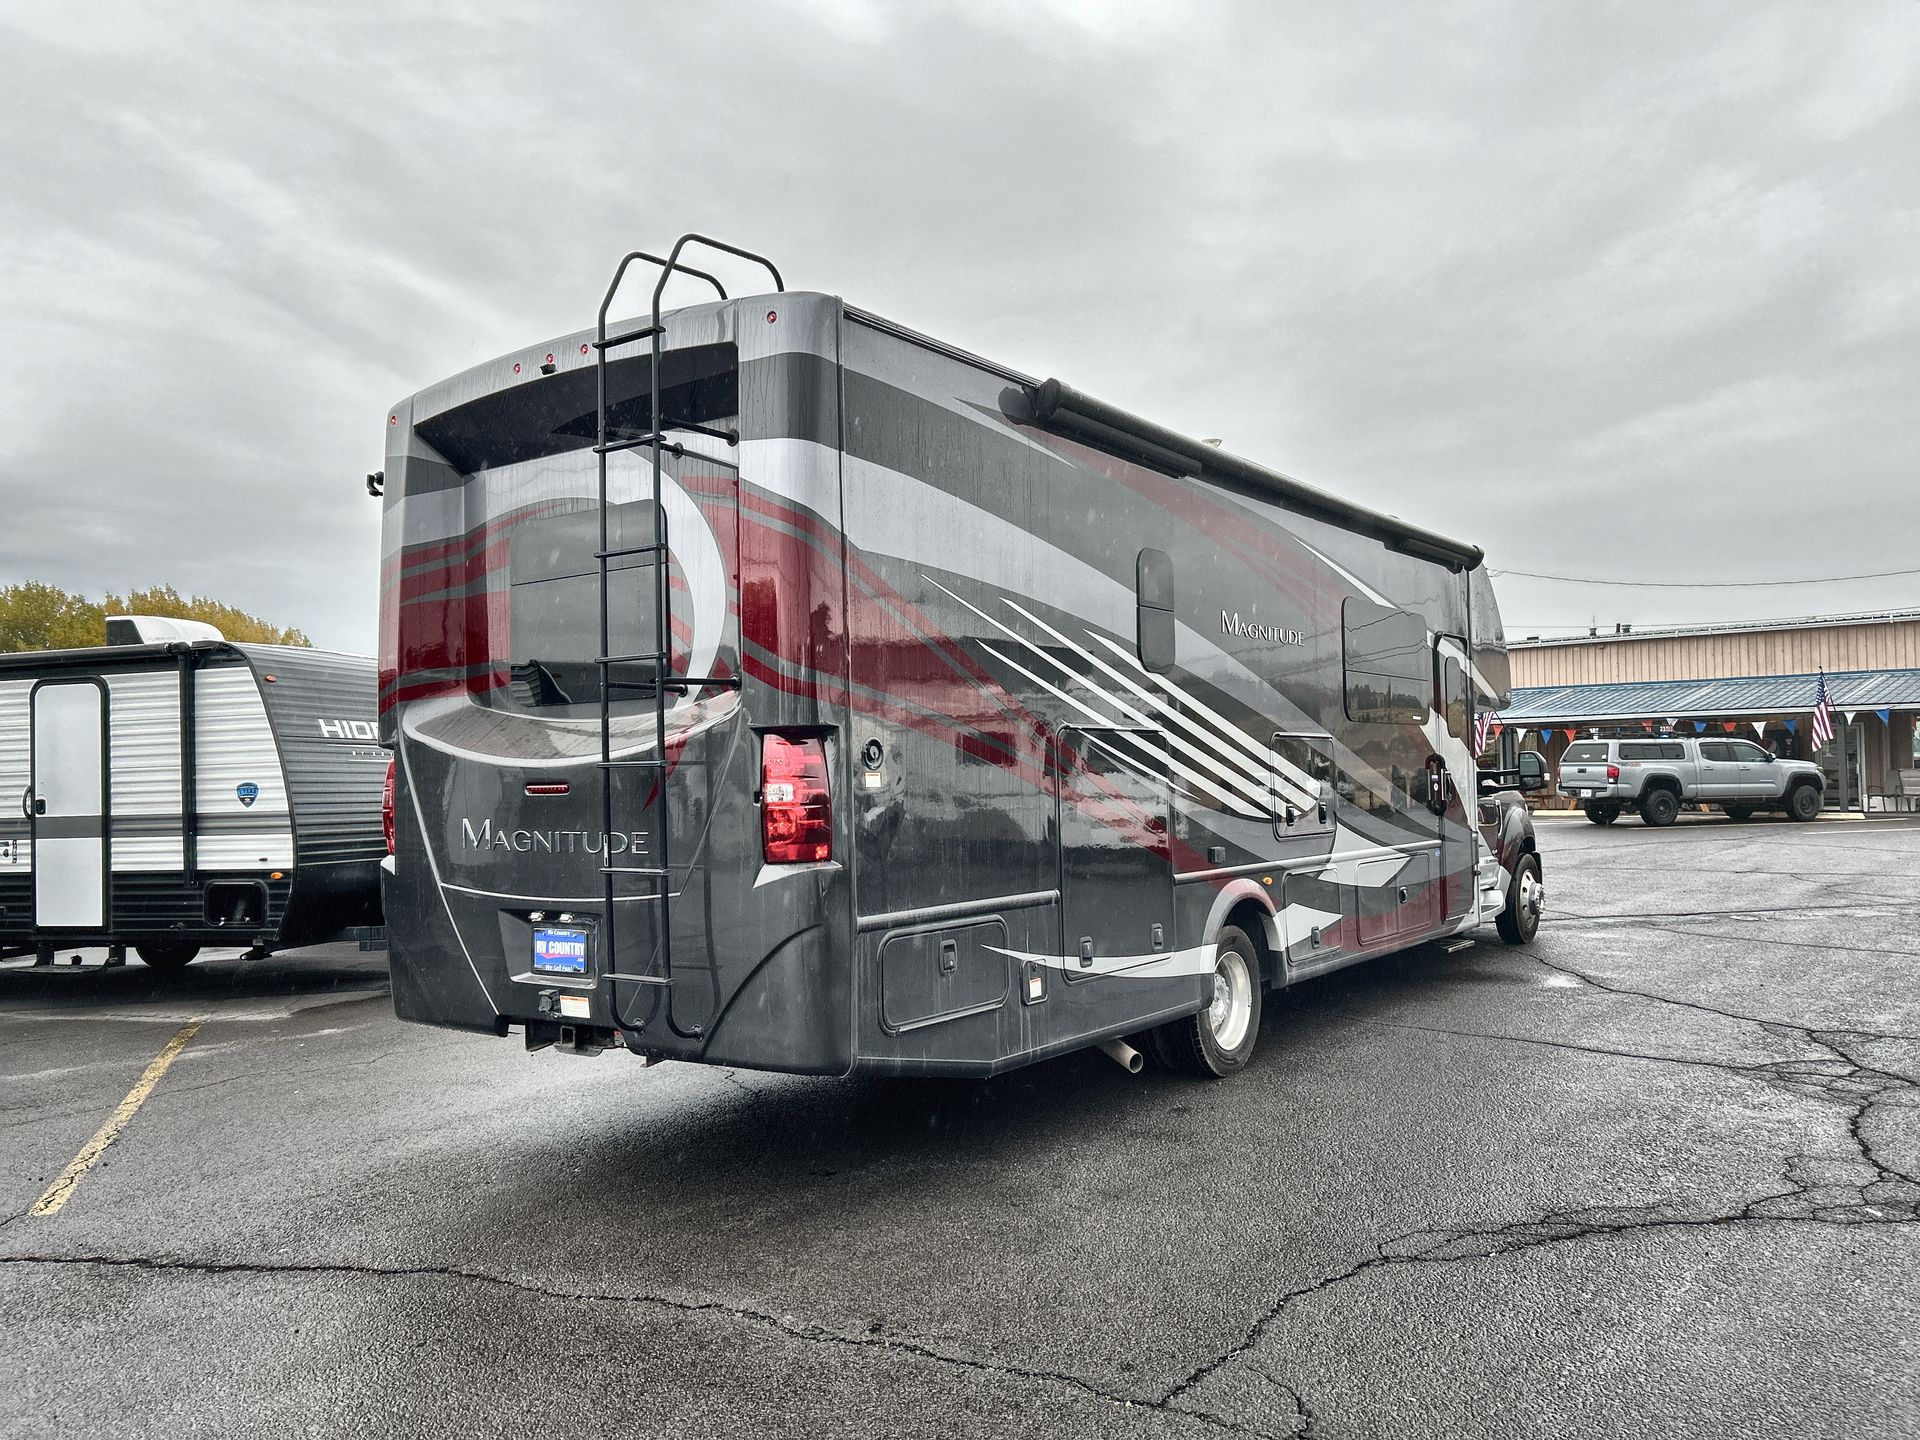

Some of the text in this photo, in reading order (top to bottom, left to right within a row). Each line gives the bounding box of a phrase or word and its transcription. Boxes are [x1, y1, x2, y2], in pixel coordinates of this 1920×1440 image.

[1221, 609, 1305, 647] MAGNITUDE
[462, 817, 650, 855] MAGNITUDE
[536, 940, 584, 956] RV COUNTRY
